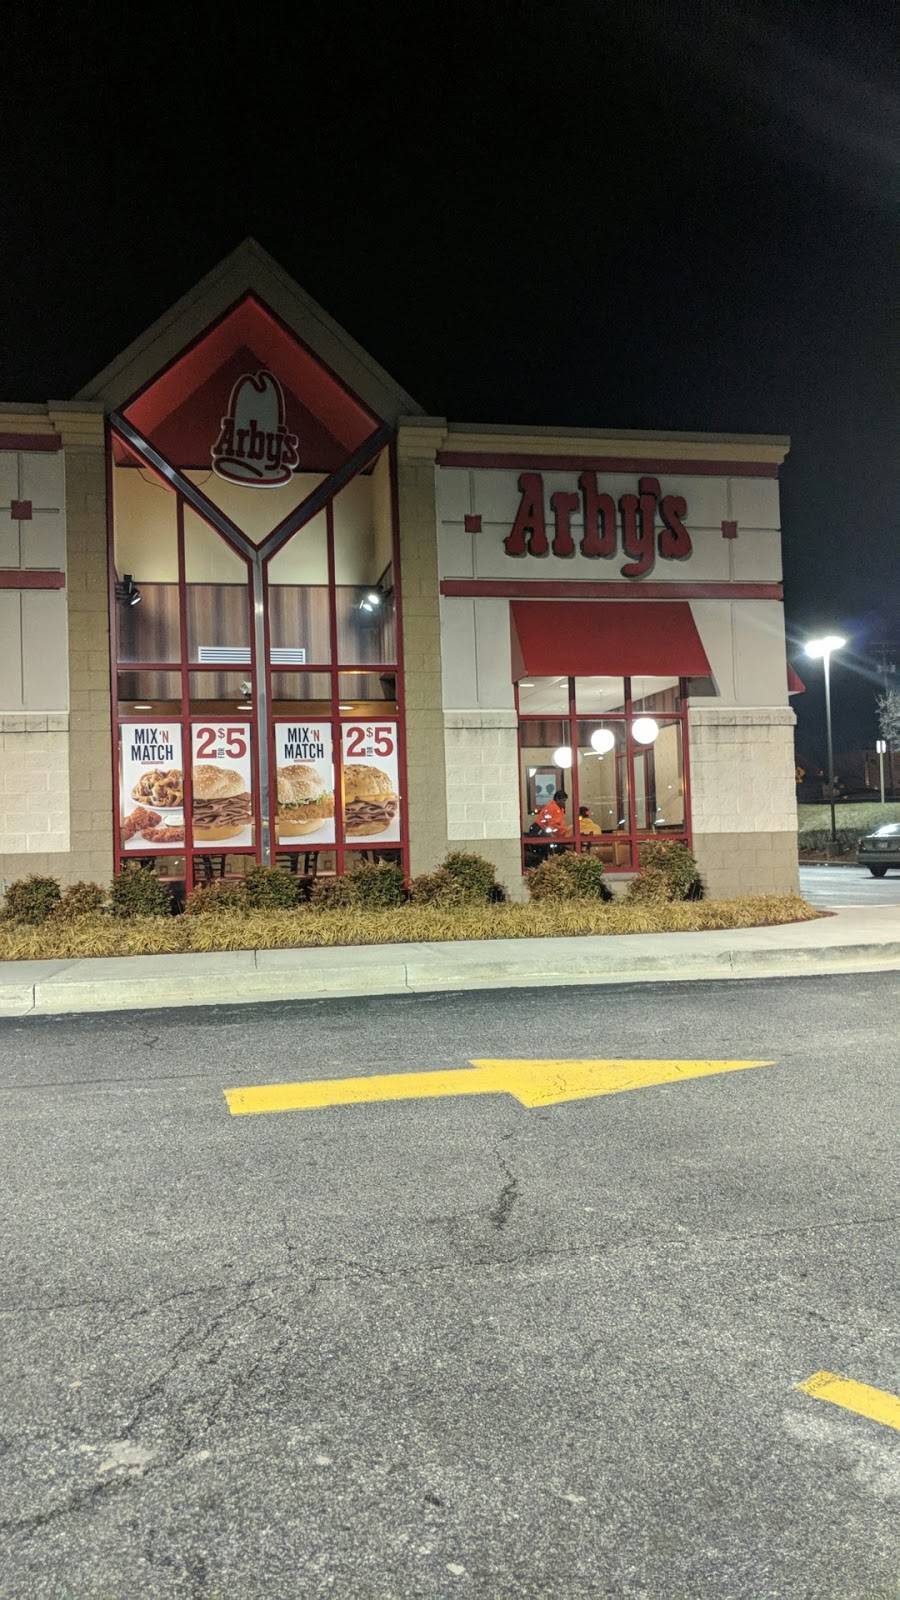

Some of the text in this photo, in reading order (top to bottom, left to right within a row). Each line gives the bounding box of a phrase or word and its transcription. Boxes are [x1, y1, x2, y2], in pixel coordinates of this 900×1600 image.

[211, 418, 299, 471] Arby's
[503, 470, 692, 578] Arby's
[134, 728, 158, 744] MIX
[196, 727, 217, 759] 2
[287, 727, 310, 743] MIX
[346, 726, 366, 757] 2
[131, 744, 174, 761] MATCH
[284, 743, 324, 759] MATCH
